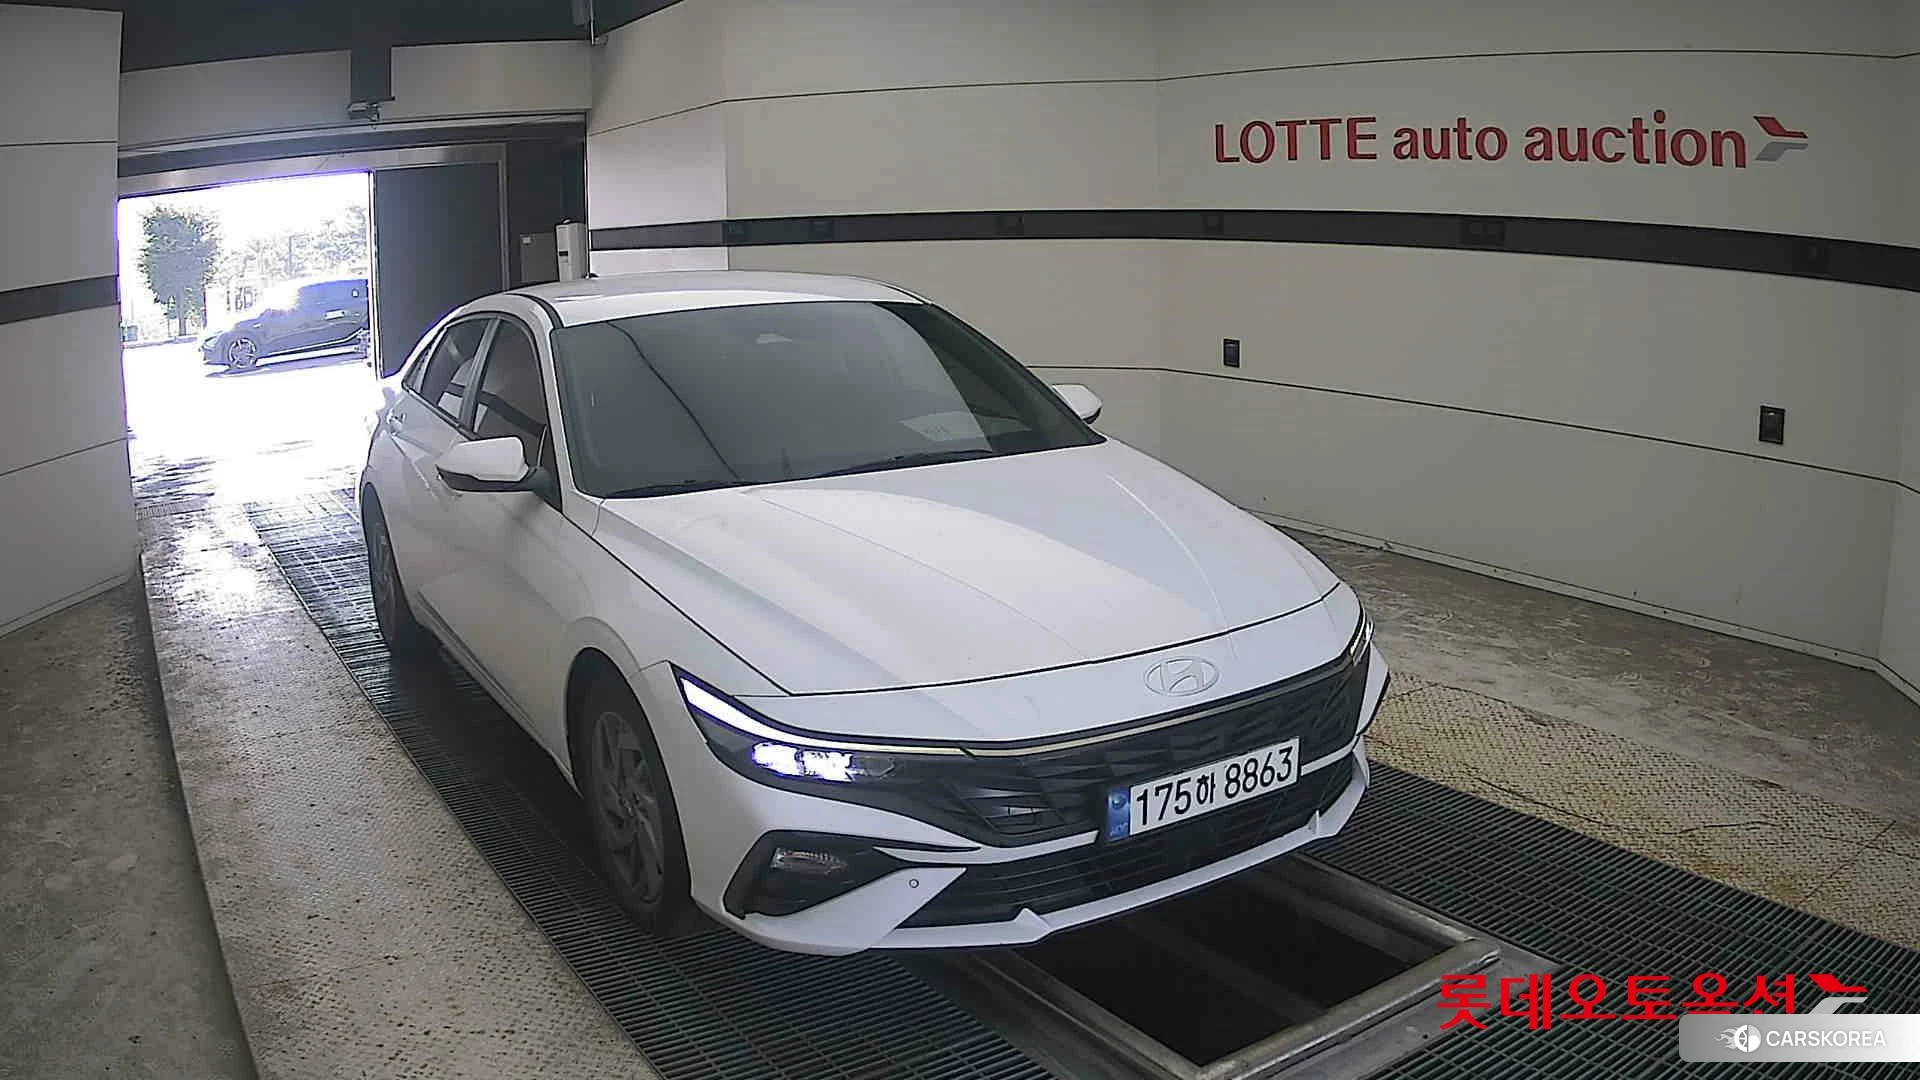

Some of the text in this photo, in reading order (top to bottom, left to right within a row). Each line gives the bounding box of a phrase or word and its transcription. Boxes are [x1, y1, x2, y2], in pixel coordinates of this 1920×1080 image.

[1214, 110, 1747, 169] LOTTE auto auction
[1136, 746, 1293, 826] 175하 8863
